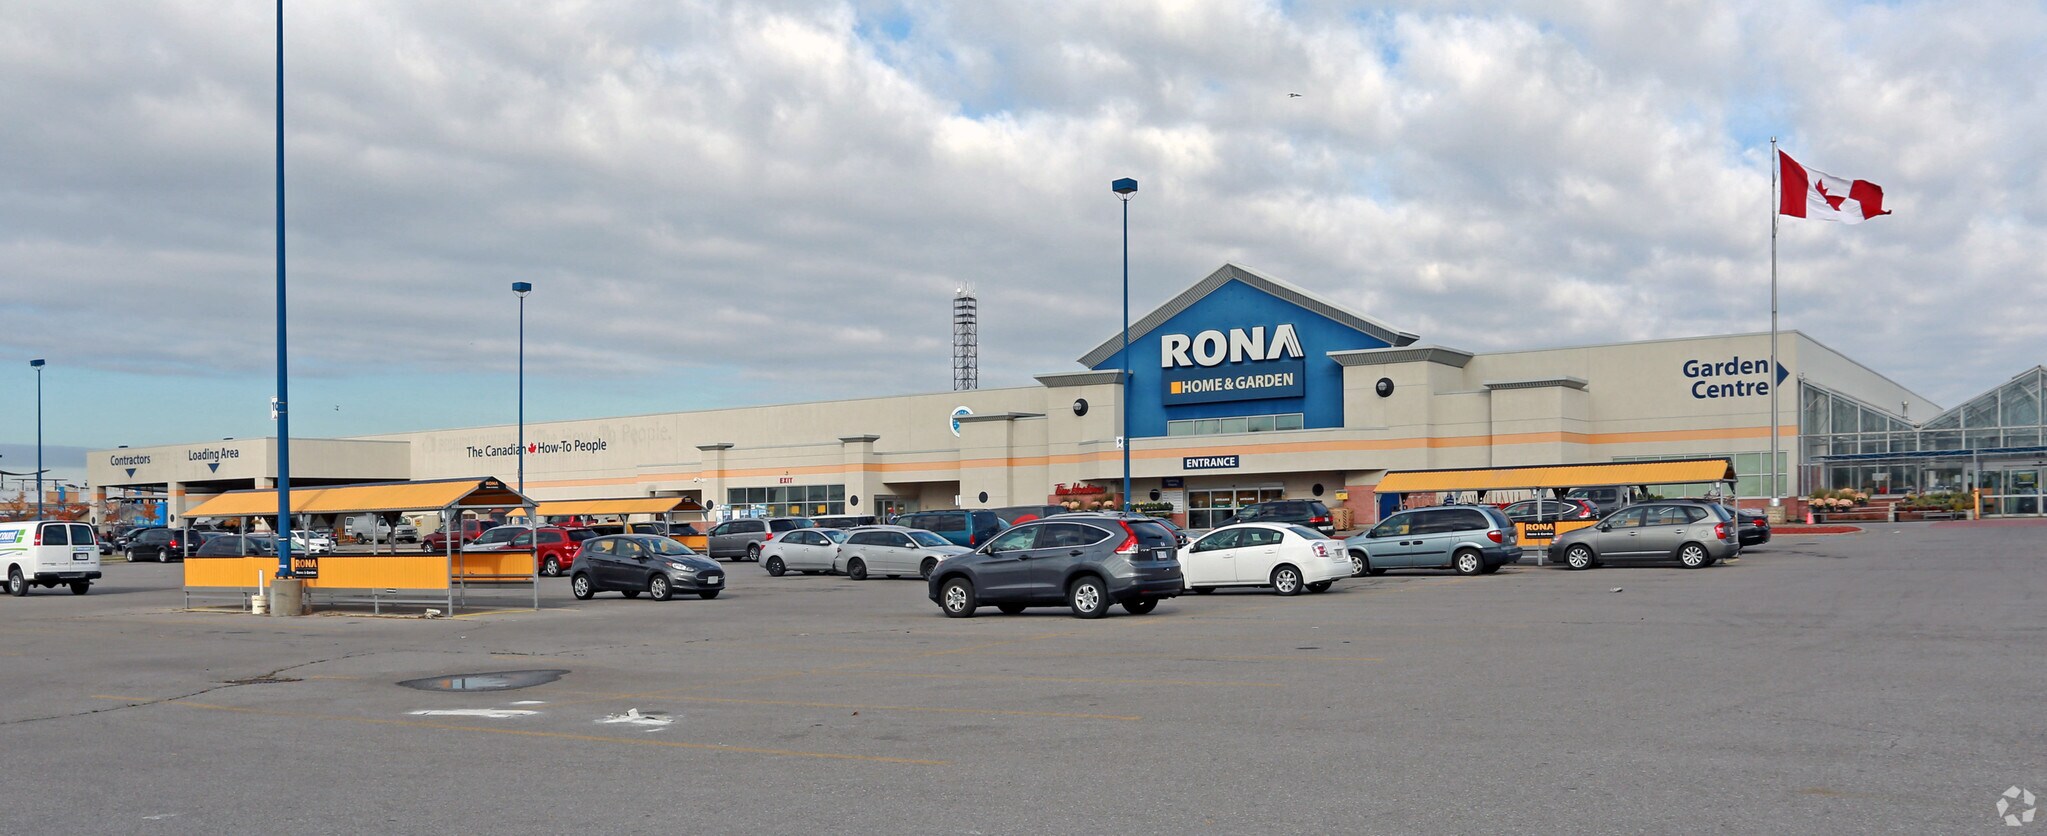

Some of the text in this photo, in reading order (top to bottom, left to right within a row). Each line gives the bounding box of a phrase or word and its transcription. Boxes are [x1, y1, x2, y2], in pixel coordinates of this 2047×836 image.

[1161, 323, 1305, 368] RONA
[1683, 356, 1768, 378] Garden
[1182, 372, 1294, 394] HOME & GARDEN
[1692, 380, 1769, 399] Centre
[188, 447, 239, 463] Loading Area
[467, 446, 483, 458] The
[485, 443, 526, 457] Canadian
[538, 440, 572, 454] How-To
[574, 438, 607, 454] People
[110, 454, 151, 466] Contractors
[1186, 456, 1236, 468] ENTRANCE
[295, 559, 317, 568] RONA
